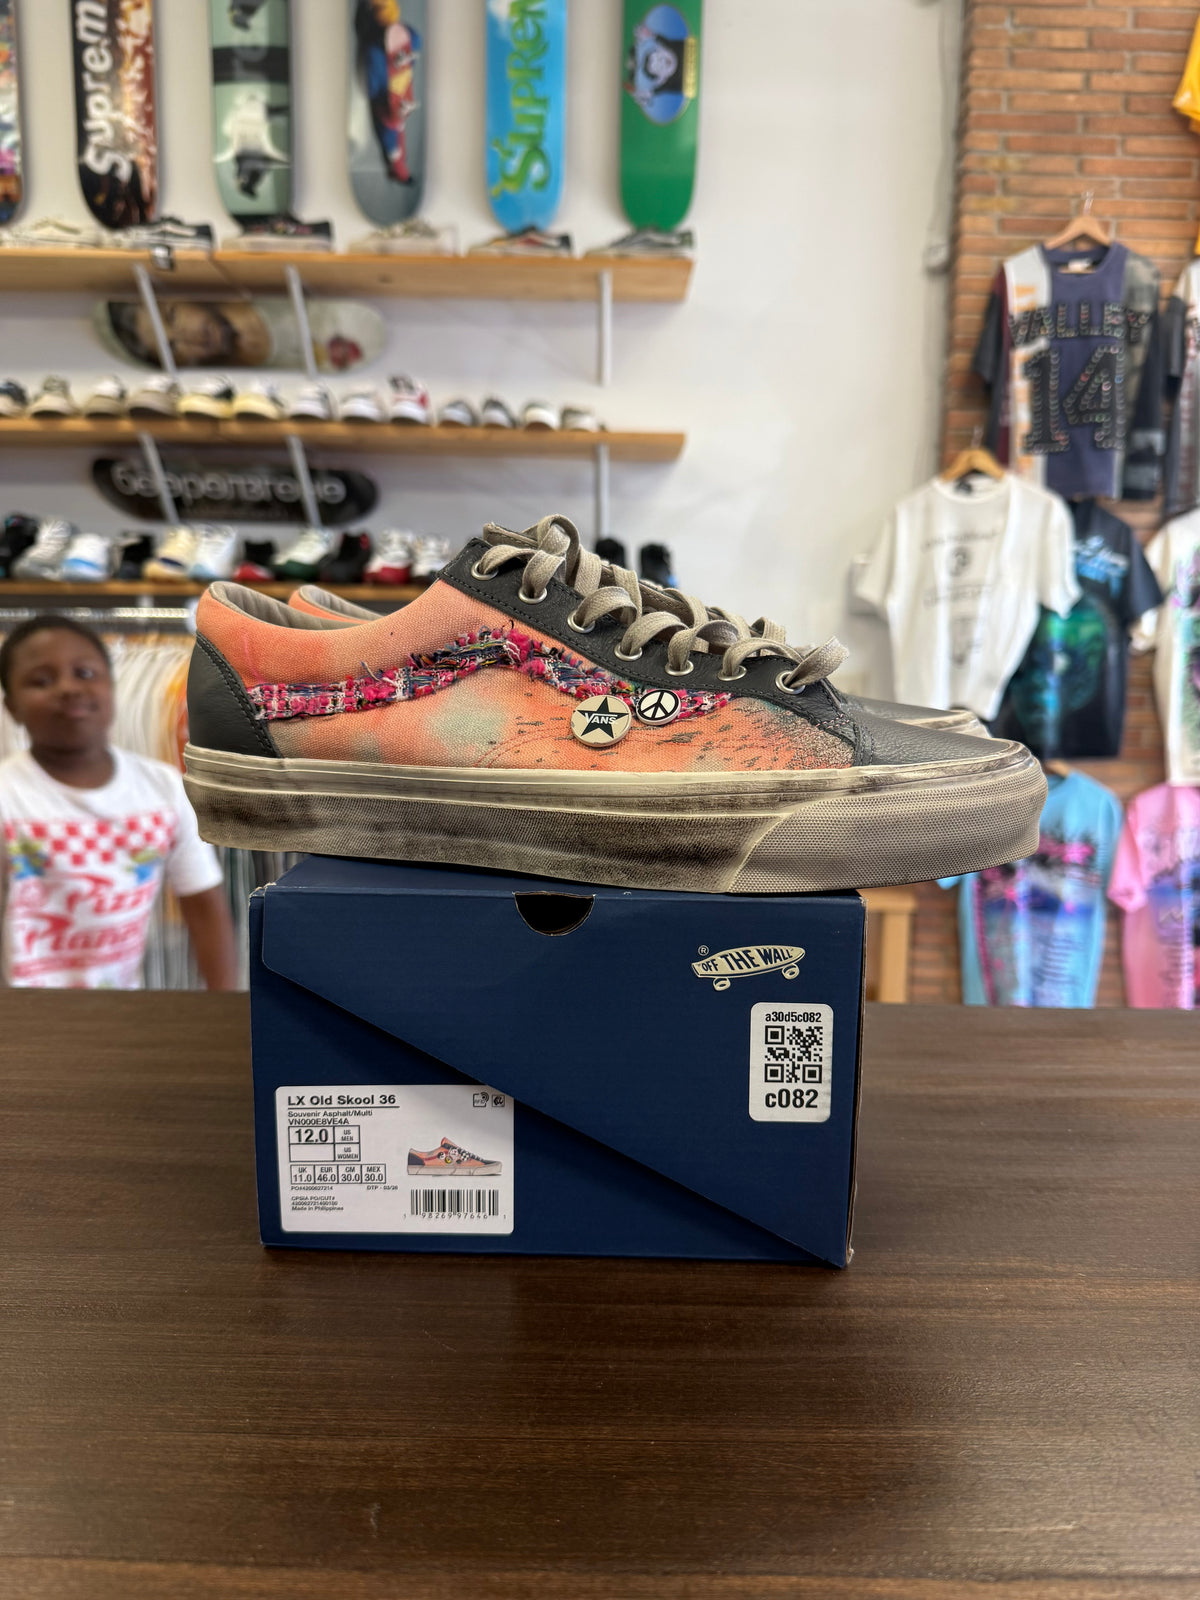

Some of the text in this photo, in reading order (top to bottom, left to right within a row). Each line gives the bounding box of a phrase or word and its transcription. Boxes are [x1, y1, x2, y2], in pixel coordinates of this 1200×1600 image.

[1007, 301, 1150, 347] VALLEY
[1023, 344, 1127, 455] 14
[585, 712, 618, 725] VANS
[720, 950, 760, 971] THE
[765, 1011, 822, 1023] a30d5c082
[288, 1094, 396, 1106] LX Old Skool 36
[765, 1088, 818, 1109] c082
[288, 1109, 373, 1118] Souvenir Asphalt/Multi
[288, 1118, 350, 1126] VN000E8VE4A
[295, 1128, 329, 1143] 12.0
[293, 1174, 312, 1182] 11.0
[317, 1174, 336, 1182] 46.0
[341, 1174, 360, 1182] 30.0
[364, 1173, 384, 1182] 30.0
[421, 1212, 453, 1220] 98269
[457, 1212, 488, 1220] 97646
